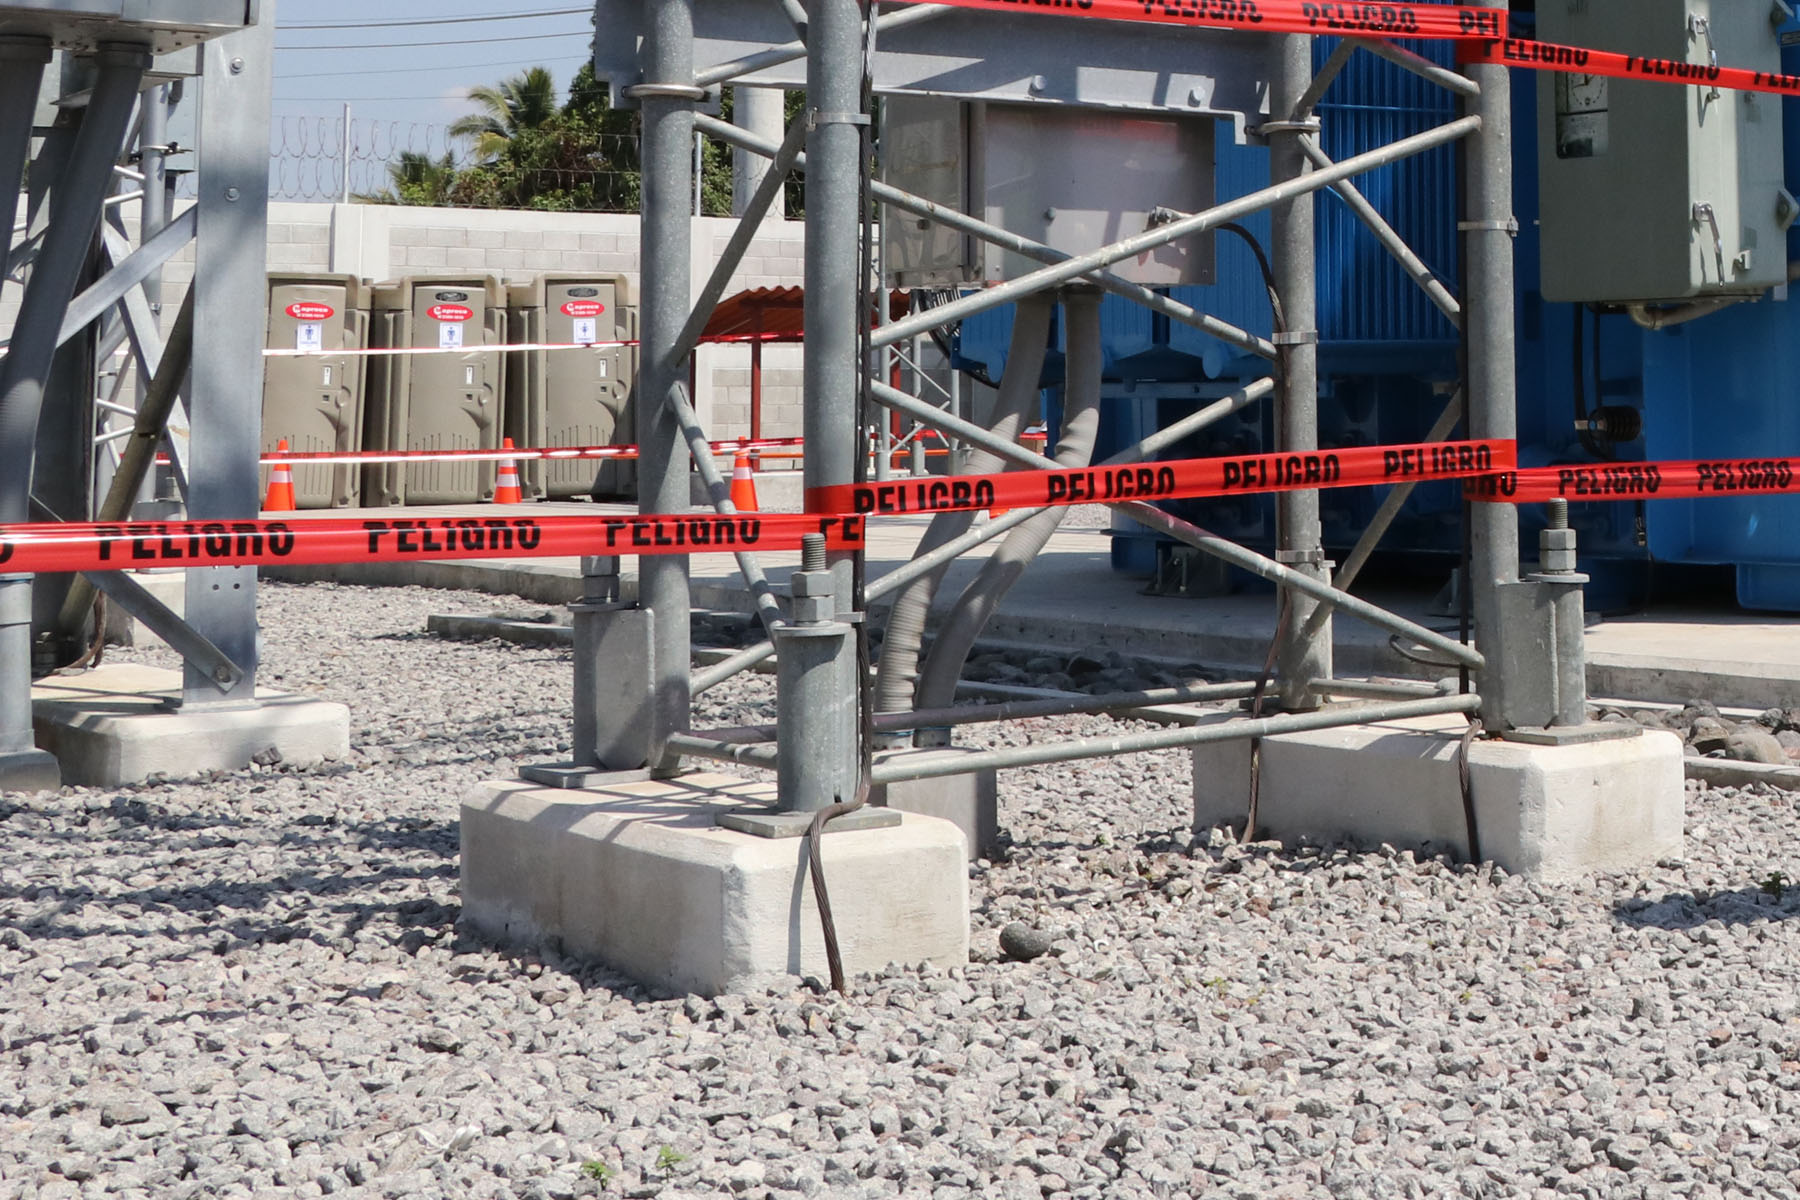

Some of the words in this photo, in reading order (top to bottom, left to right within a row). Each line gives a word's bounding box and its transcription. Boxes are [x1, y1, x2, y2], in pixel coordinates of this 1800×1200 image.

[1302, 2, 1420, 34] PELIGRO
[1223, 454, 1341, 490] PELIGRO
[1383, 445, 1492, 478] PELIGRO
[1697, 460, 1794, 492] PELIGRO
[854, 478, 996, 514] PELIGRO
[1047, 467, 1176, 503] PELIGRO
[1558, 465, 1662, 496] PELIGRO
[96, 522, 294, 561] PELIGRO
[362, 520, 542, 554] PELIGRO
[604, 517, 761, 547] PELIGRO
